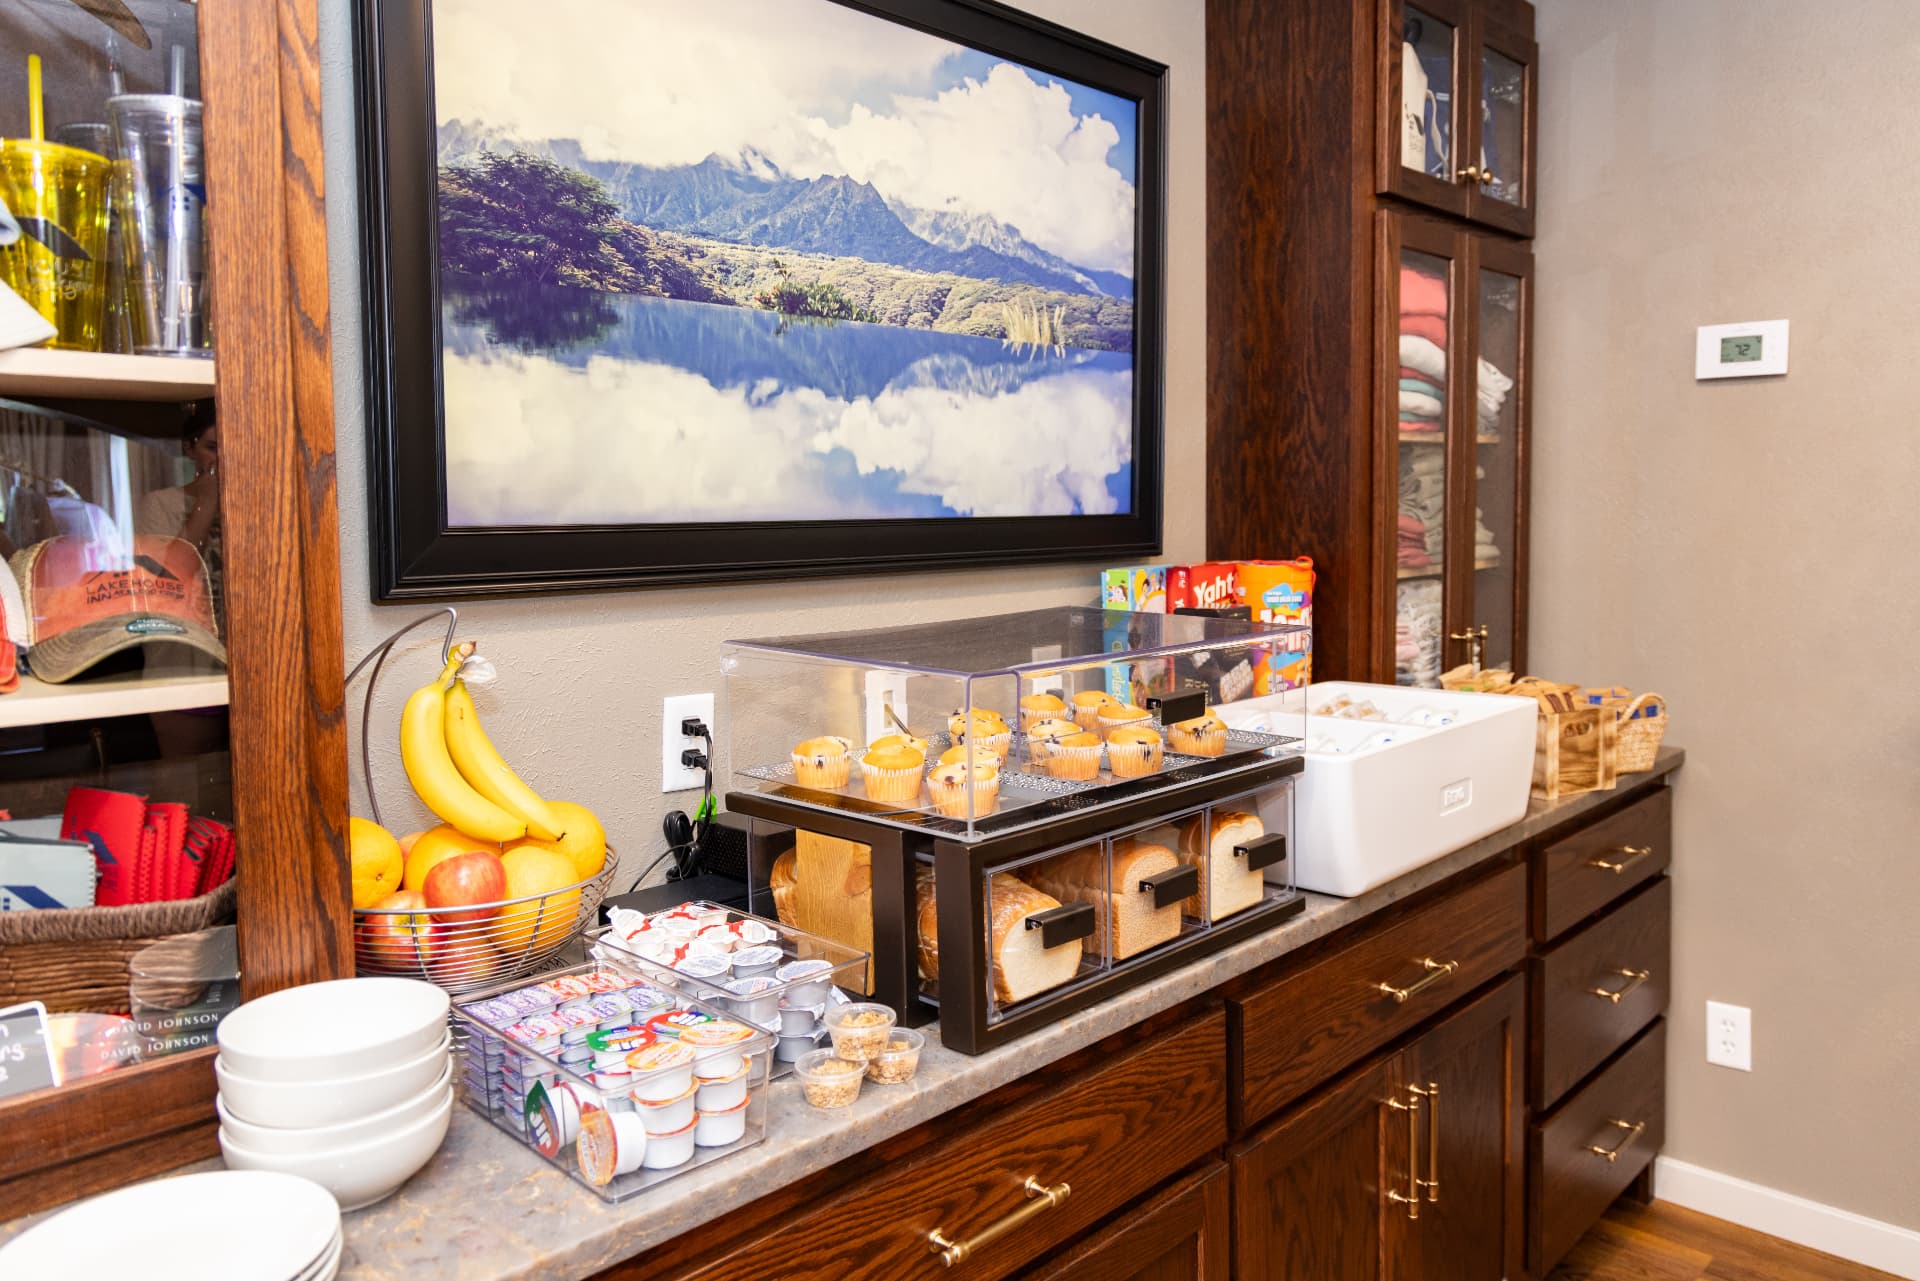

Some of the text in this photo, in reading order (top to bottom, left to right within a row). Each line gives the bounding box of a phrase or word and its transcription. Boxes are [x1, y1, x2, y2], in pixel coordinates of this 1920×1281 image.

[1193, 572, 1234, 608] Yaht
[112, 1013, 219, 1034] DAVID JOHNSON
[101, 1034, 209, 1059] DAVID JOHNSON
